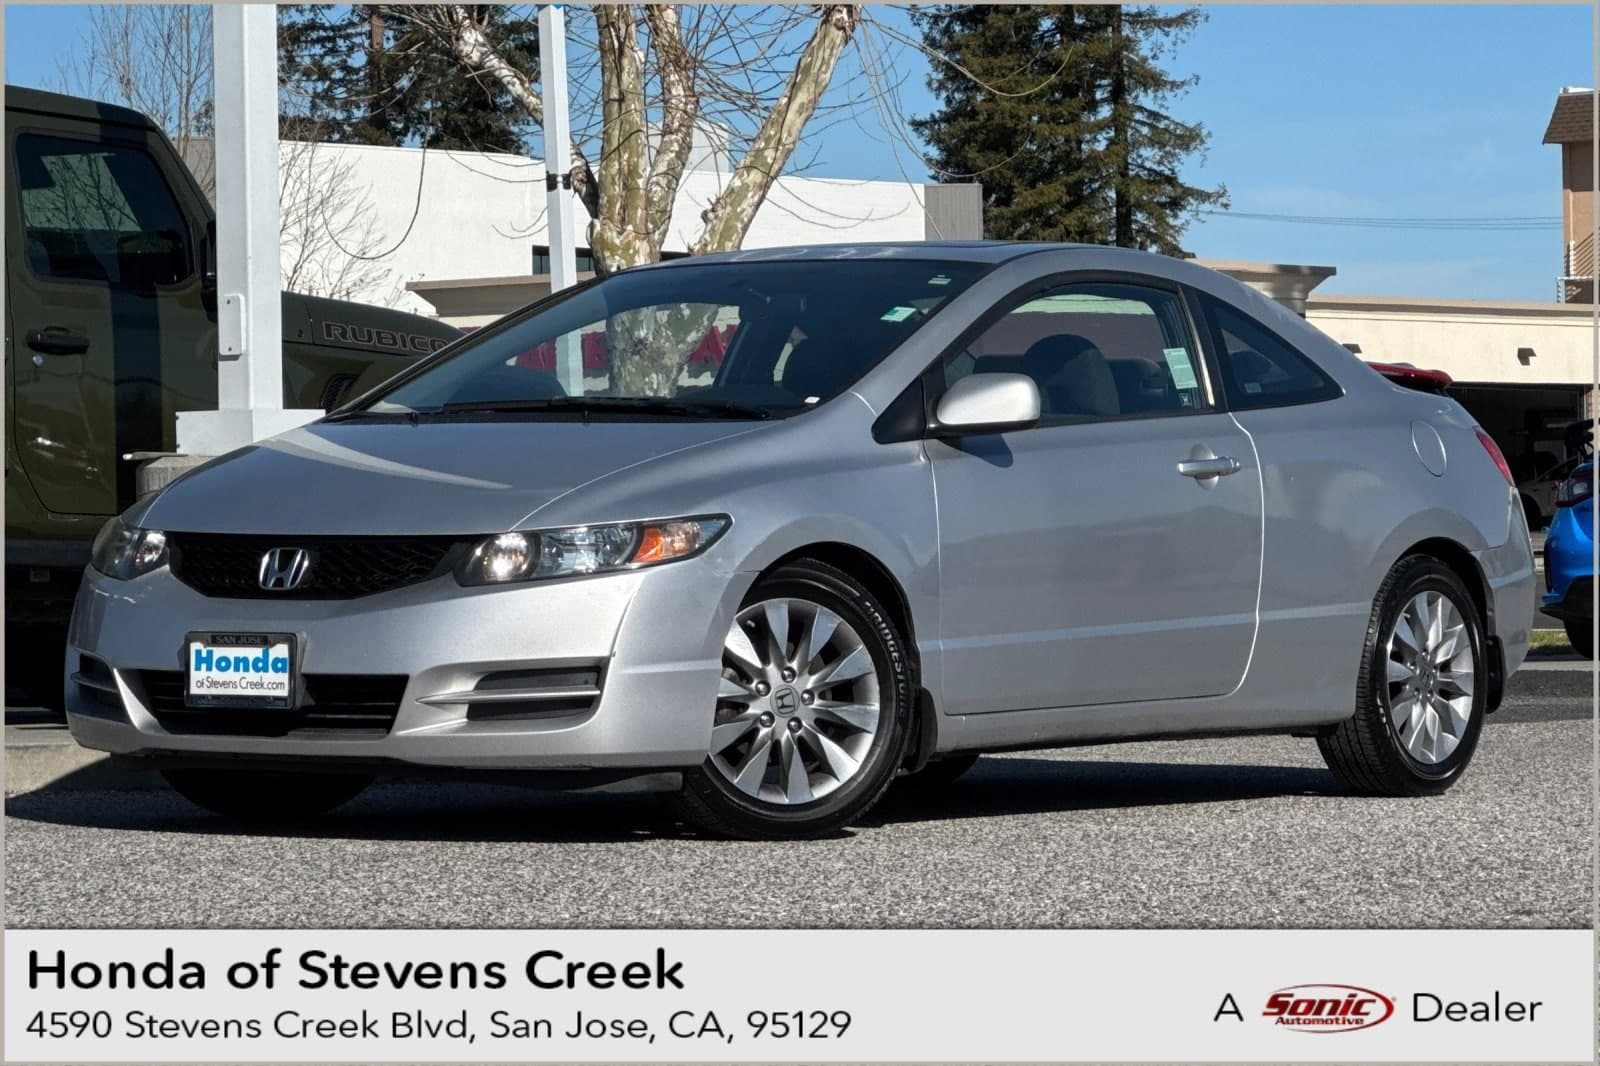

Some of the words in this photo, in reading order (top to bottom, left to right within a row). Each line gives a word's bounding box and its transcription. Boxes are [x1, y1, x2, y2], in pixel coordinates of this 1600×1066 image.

[215, 634, 237, 644] SAN
[238, 635, 265, 645] JOSE
[194, 648, 288, 674] Honda
[195, 676, 206, 689] of
[206, 675, 238, 690] Stevens
[239, 676, 285, 690] Creek.com
